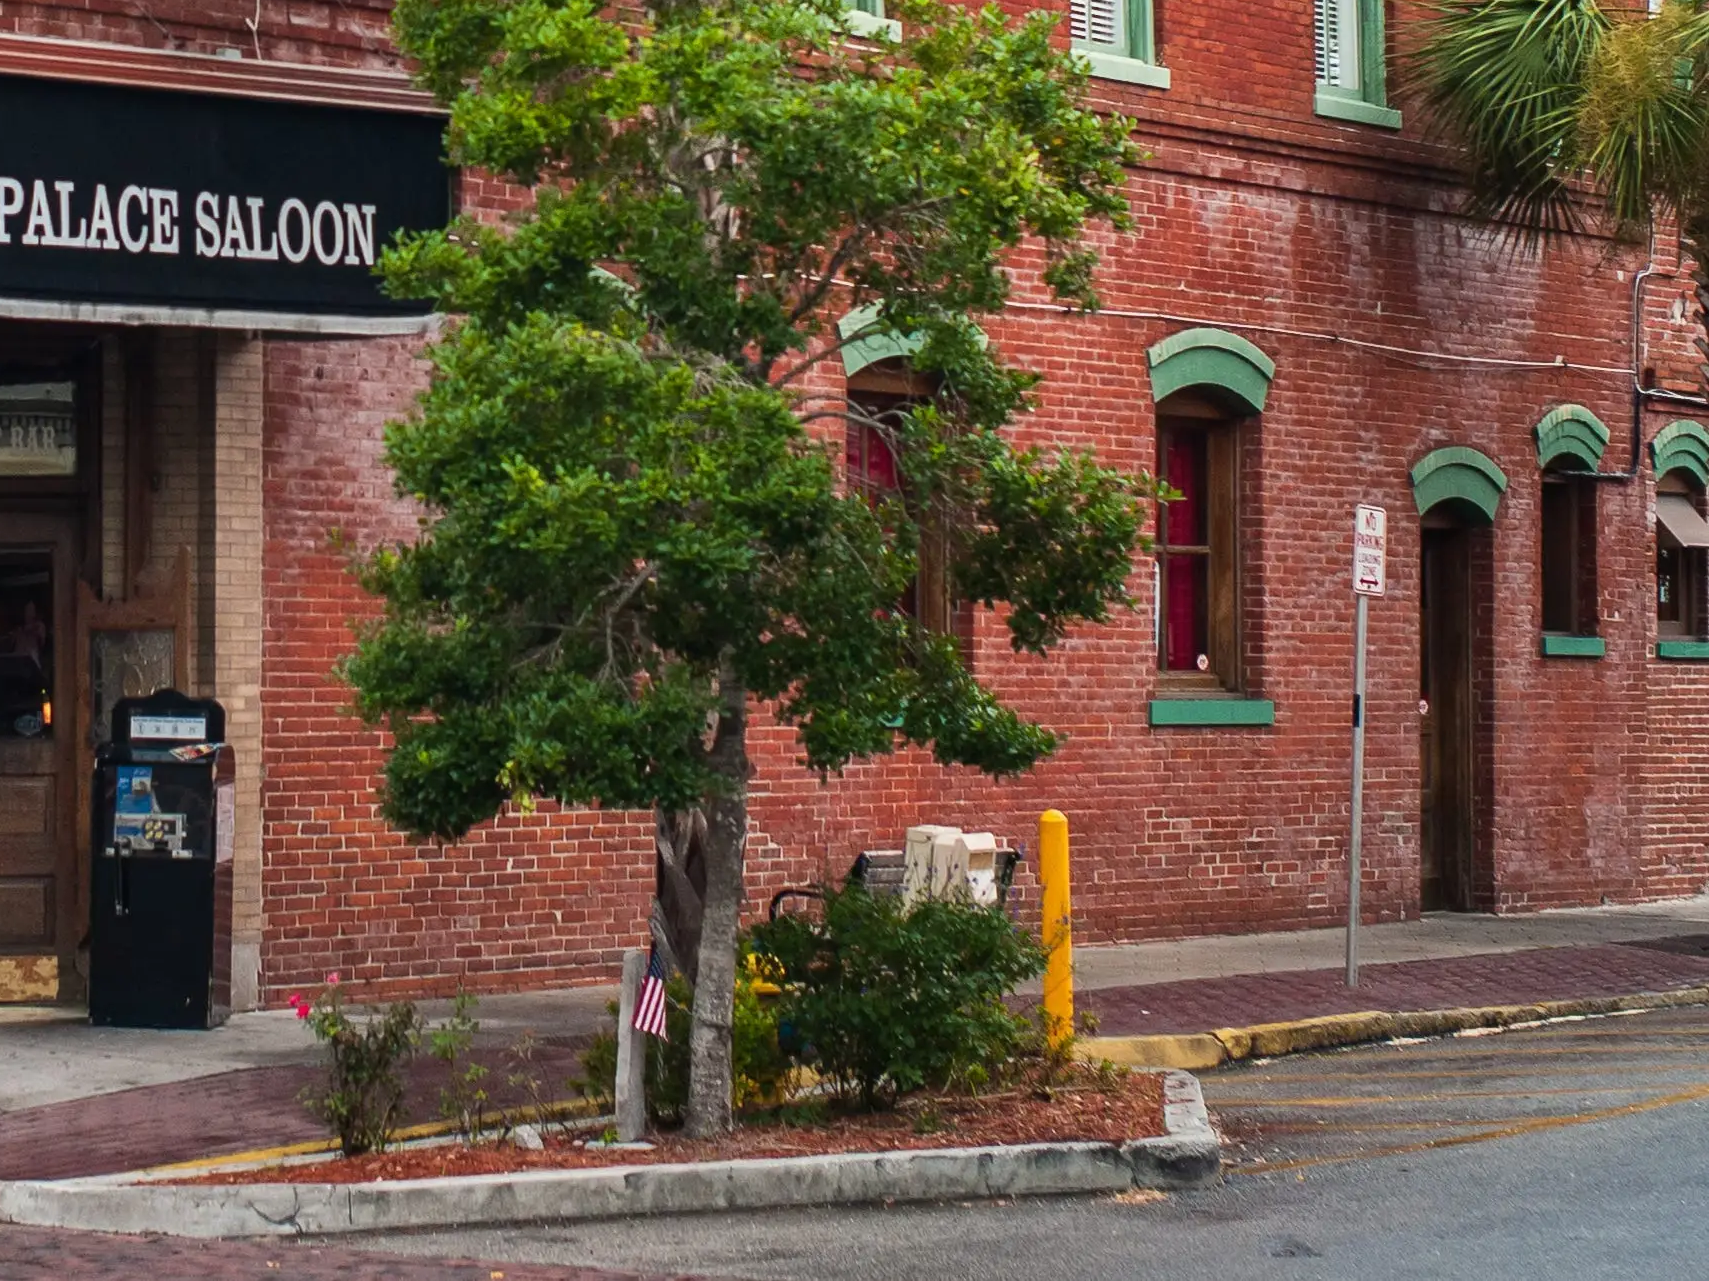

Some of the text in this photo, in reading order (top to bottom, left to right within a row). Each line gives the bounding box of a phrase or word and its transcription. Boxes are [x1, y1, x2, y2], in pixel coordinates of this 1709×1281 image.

[194, 190, 376, 267] SALOON
[10, 425, 56, 452] BAR
[1365, 514, 1377, 531] NO
